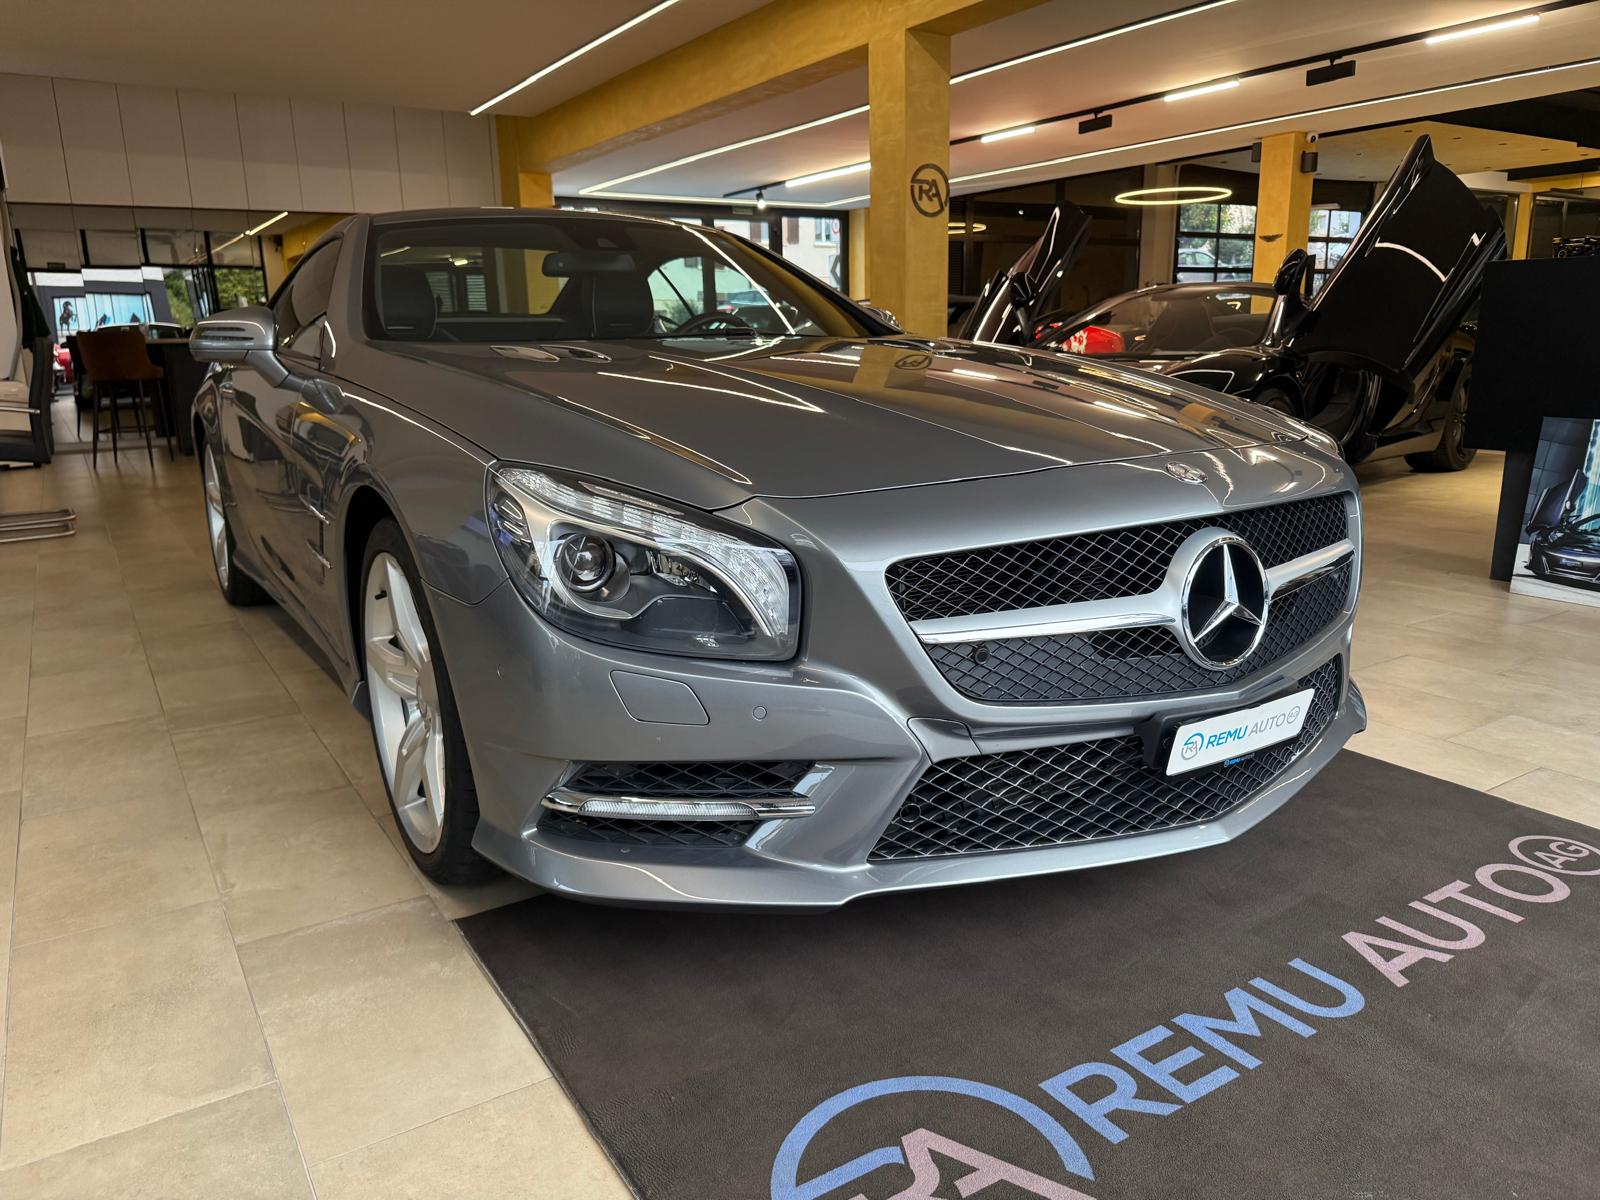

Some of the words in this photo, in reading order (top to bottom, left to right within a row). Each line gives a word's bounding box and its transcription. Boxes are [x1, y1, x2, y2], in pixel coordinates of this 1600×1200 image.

[1206, 725, 1248, 749] REMU
[1248, 713, 1286, 736] AUTO
[1038, 957, 1366, 1145] REMU
[1341, 863, 1571, 987] AUTO
[1534, 841, 1590, 869] AG
